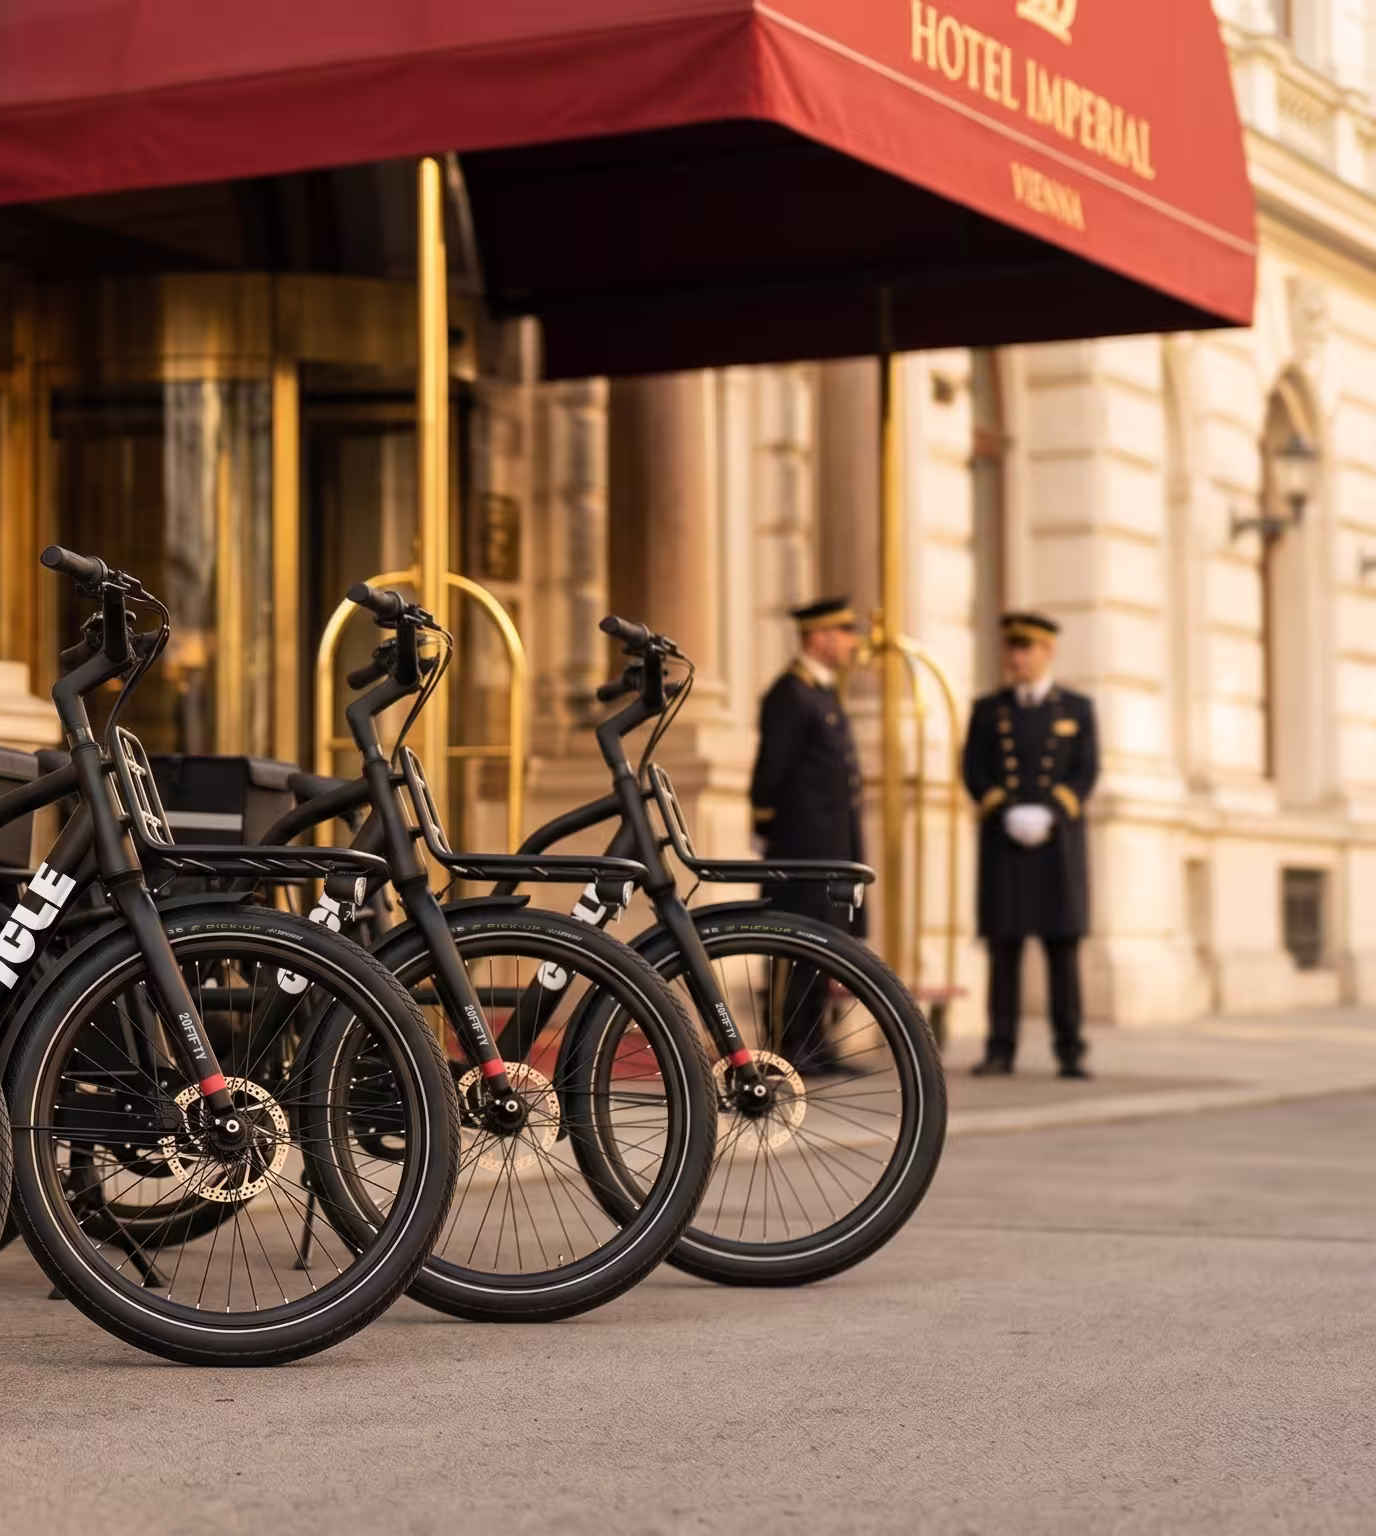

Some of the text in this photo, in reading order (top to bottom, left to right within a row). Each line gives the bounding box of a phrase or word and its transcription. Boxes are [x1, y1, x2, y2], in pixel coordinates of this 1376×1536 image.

[911, 0, 1156, 181] HOTEL IMPERIAL
[178, 1012, 208, 1060] 20FIFTY
[464, 1004, 489, 1046] 20FIFTY
[715, 1002, 737, 1038] 20FIFTY
